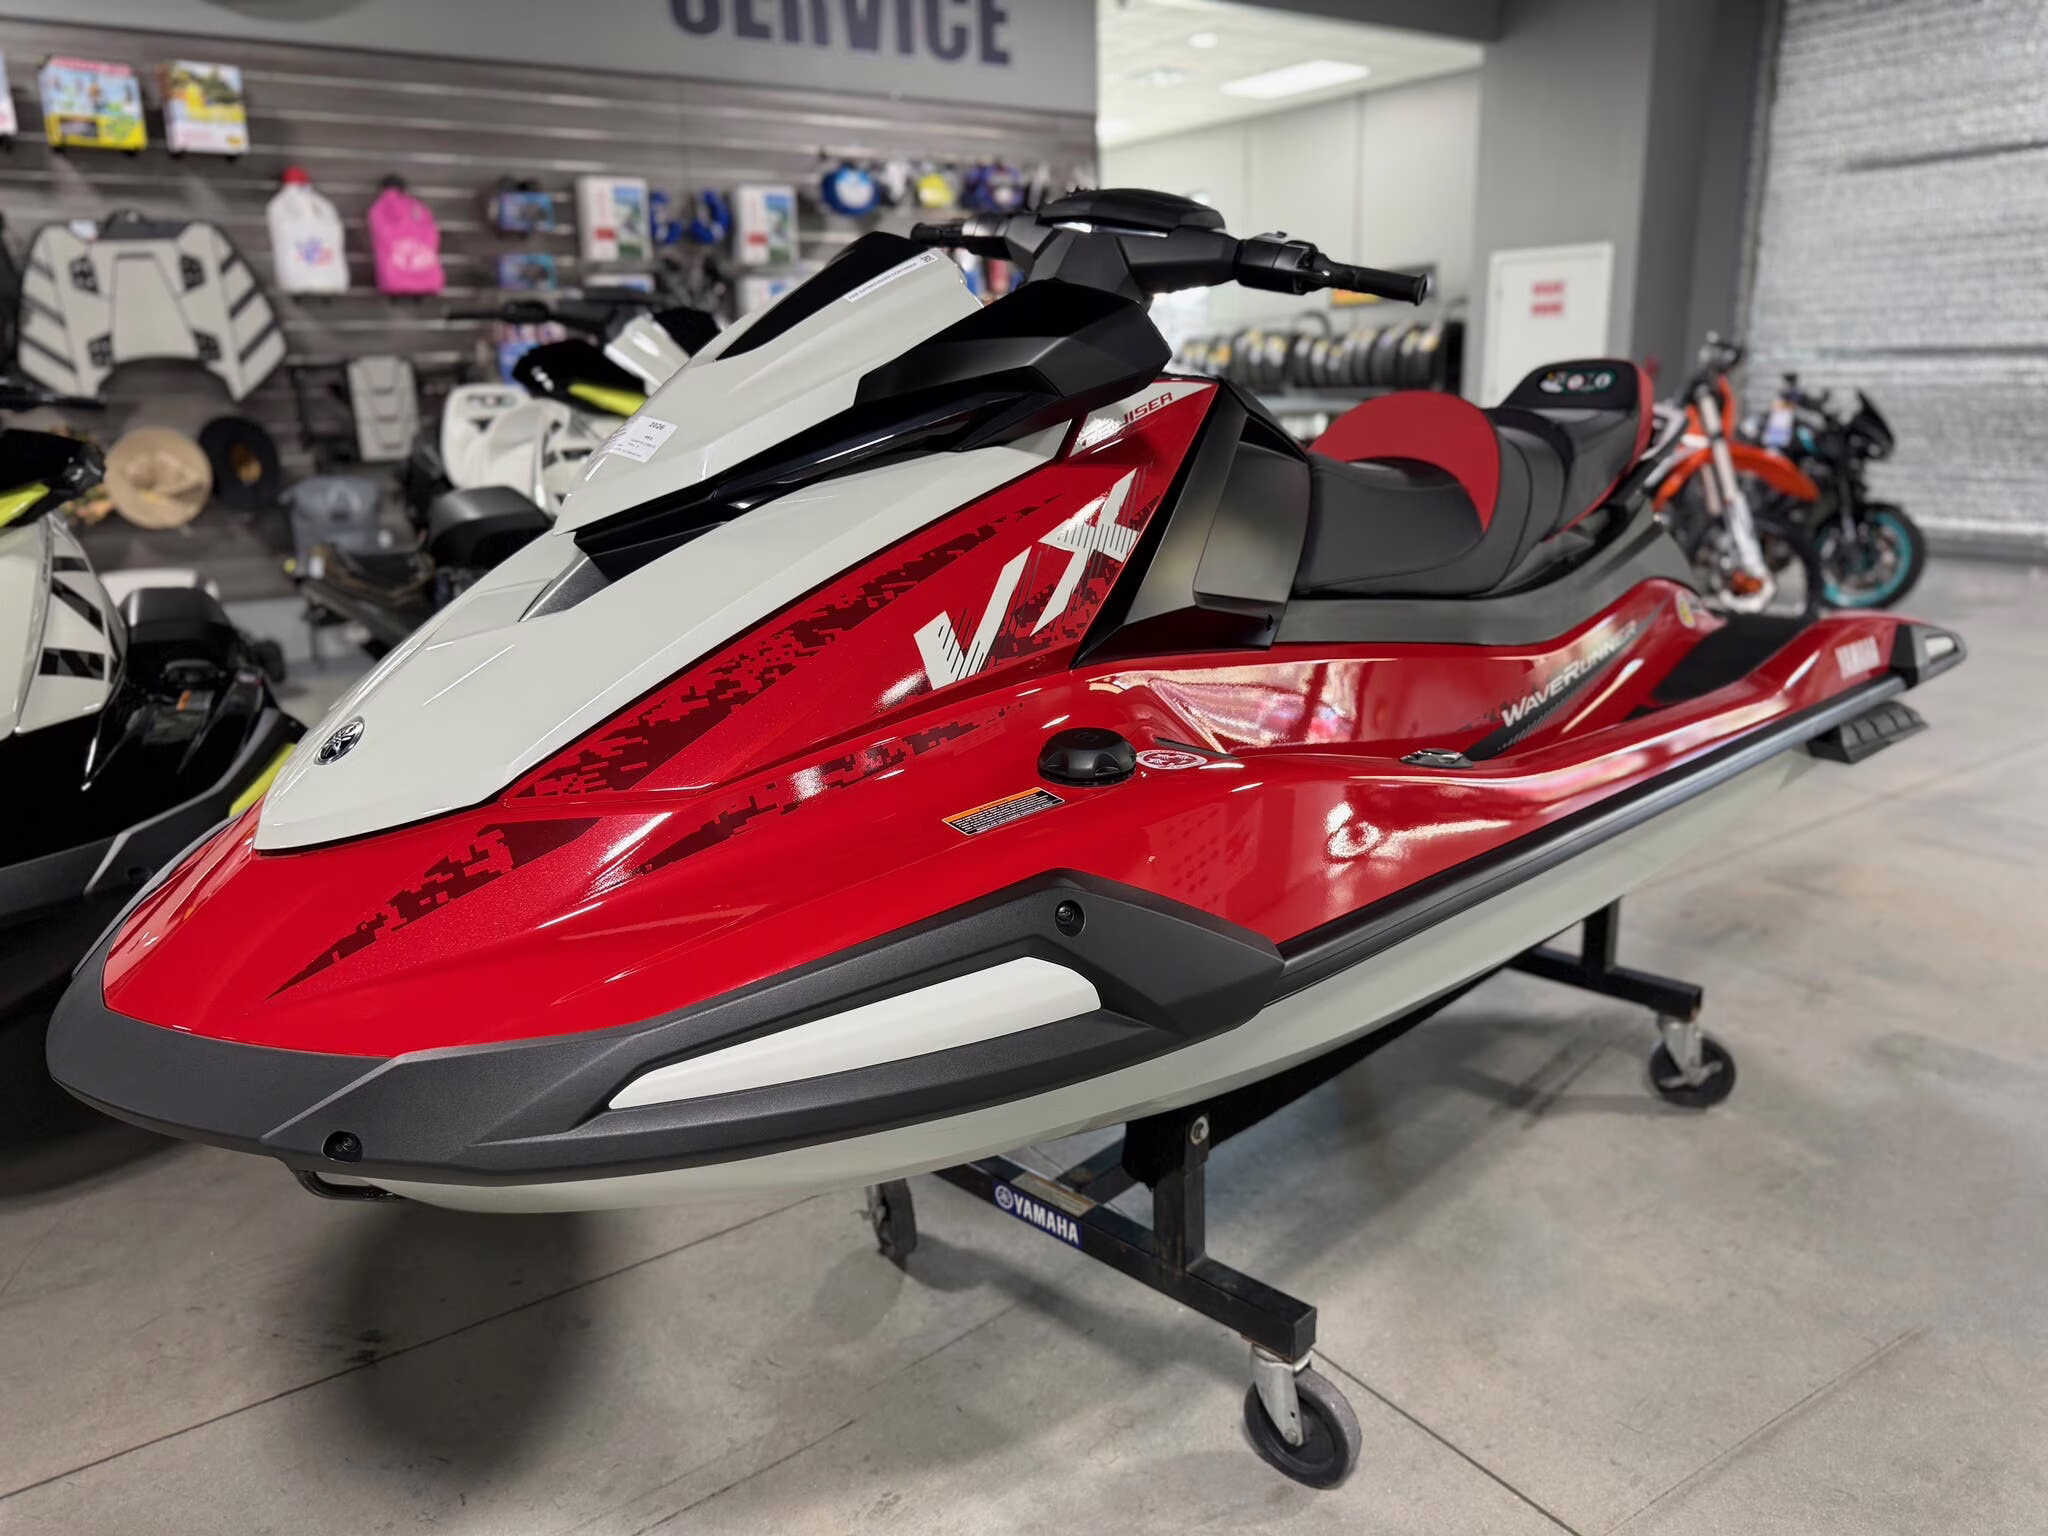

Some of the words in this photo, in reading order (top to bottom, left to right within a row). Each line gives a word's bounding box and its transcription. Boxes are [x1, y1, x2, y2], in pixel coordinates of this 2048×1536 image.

[1079, 391, 1174, 447] UISER
[913, 467, 1139, 691] VX
[1013, 1193, 1079, 1245] YAMAHA
